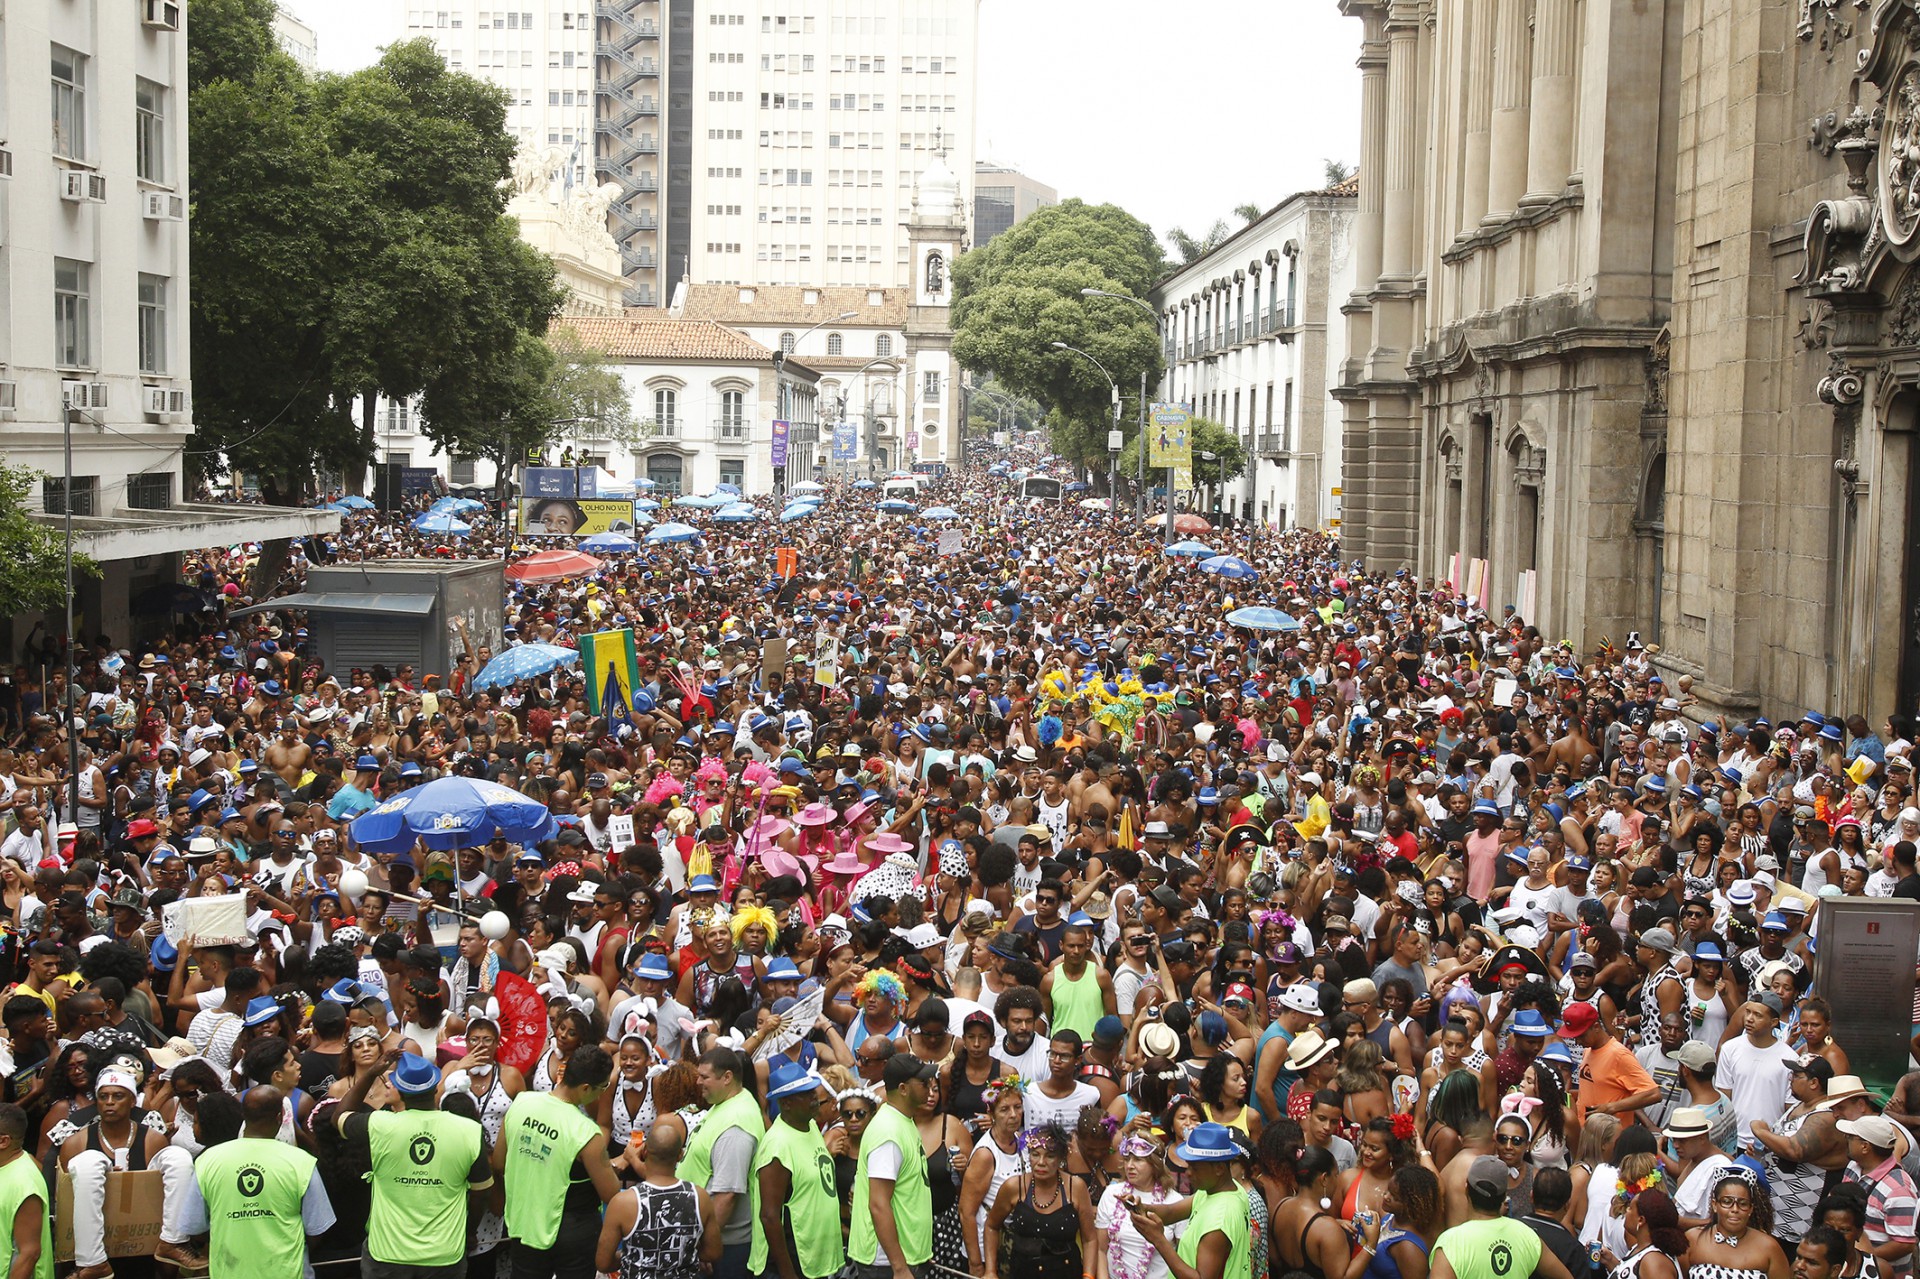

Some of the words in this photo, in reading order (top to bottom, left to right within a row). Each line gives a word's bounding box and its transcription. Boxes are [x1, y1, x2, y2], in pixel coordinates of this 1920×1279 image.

[522, 1116, 559, 1141] APOIO
[400, 1177, 444, 1186] DIMONA
[232, 1209, 277, 1219] DIMONA
